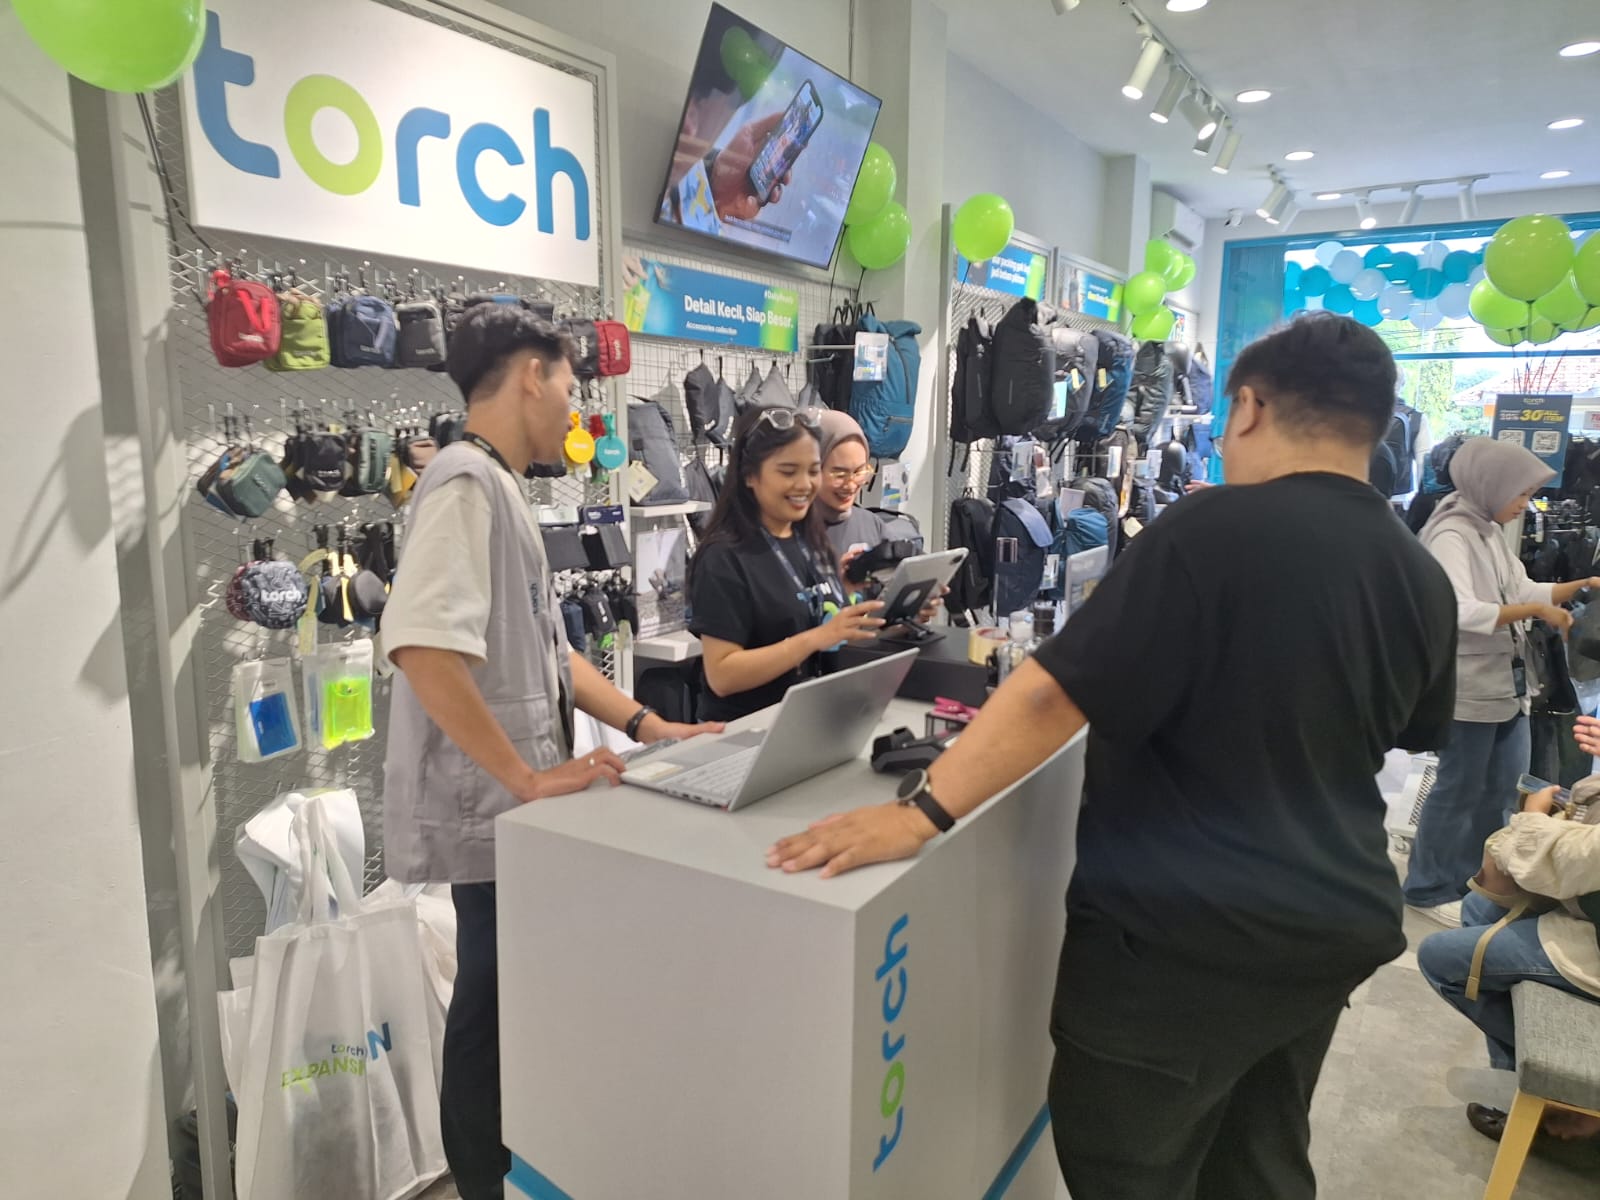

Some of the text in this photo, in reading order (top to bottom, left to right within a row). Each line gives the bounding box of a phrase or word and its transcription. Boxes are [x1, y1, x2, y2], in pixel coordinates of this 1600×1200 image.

[193, 10, 590, 241] torch
[684, 295, 794, 329] Detail Kecil, Siap Besar.
[261, 586, 302, 602] torch
[873, 913, 909, 1173] torch
